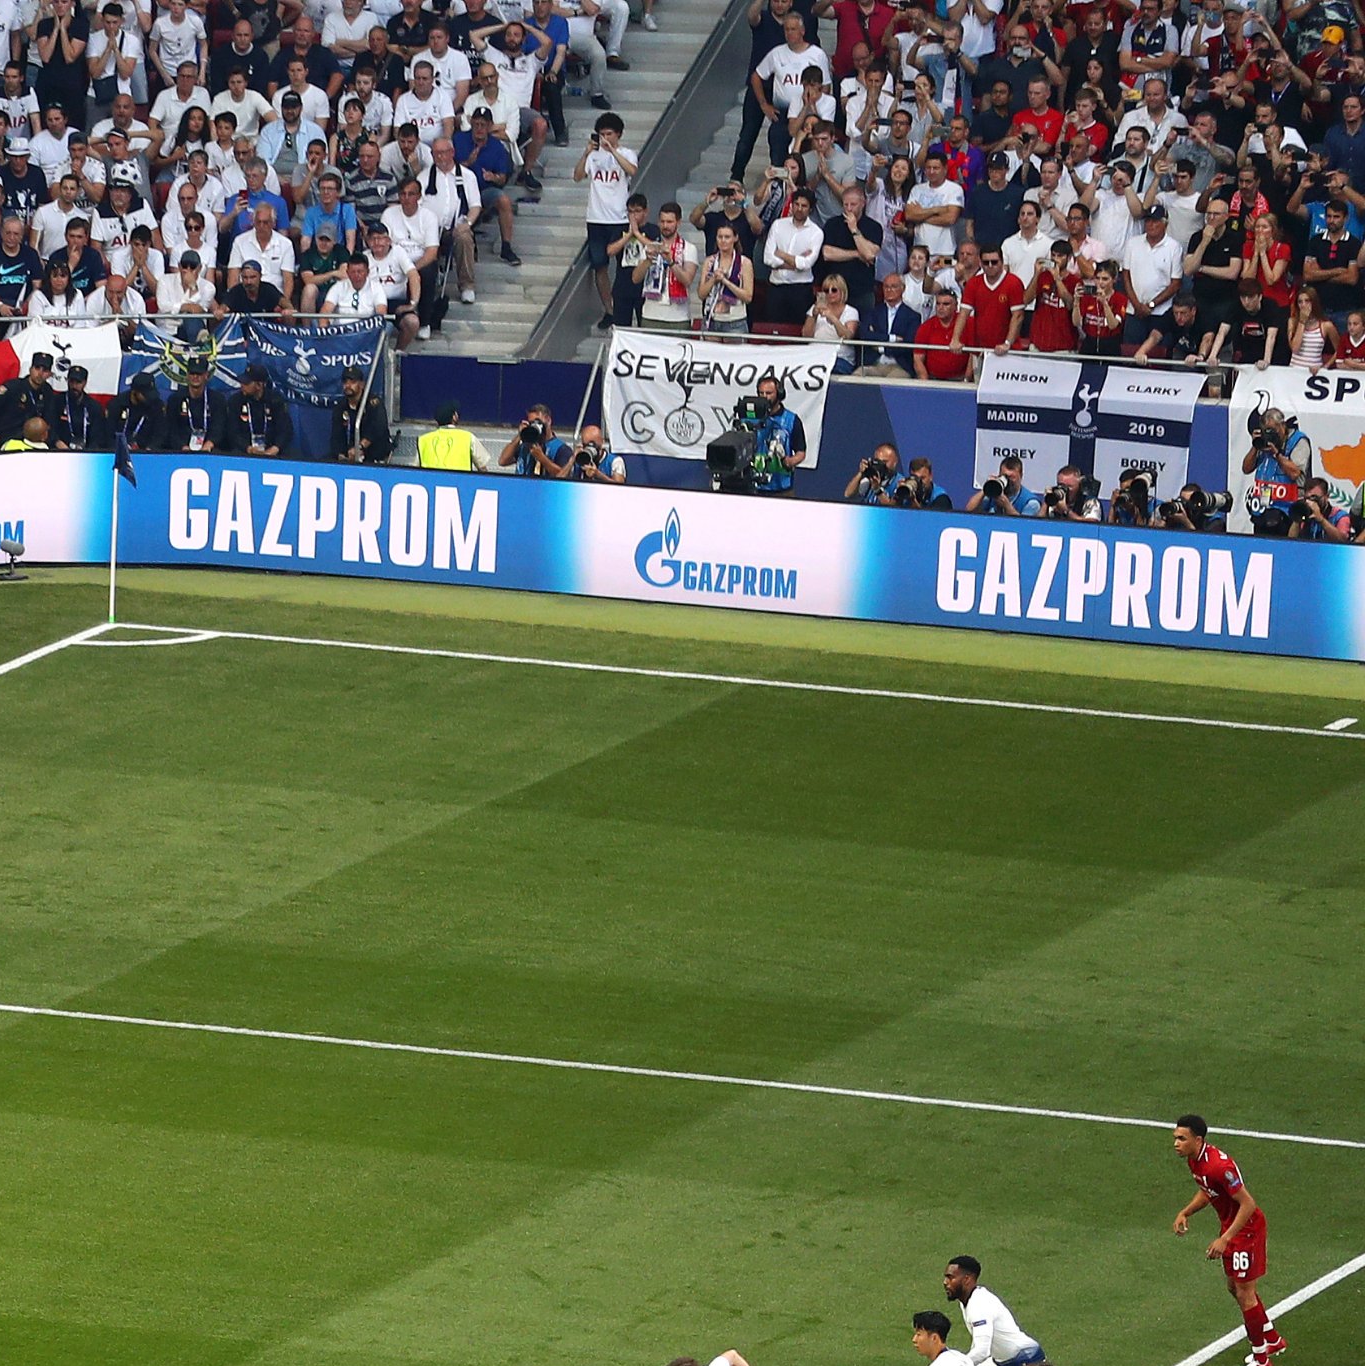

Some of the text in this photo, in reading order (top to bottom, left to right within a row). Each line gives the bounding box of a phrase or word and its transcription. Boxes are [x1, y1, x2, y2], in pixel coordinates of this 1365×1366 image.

[593, 169, 621, 183] AIA
[316, 315, 384, 337] HOTSPUR
[613, 350, 827, 392] SEVENOAKS
[996, 371, 1049, 384] HINSON
[1126, 384, 1183, 397] CLARKY
[987, 409, 1038, 424] MADRID
[1128, 421, 1165, 438] 2019
[992, 447, 1037, 460] ROSEY
[1120, 458, 1167, 472] BOBBY
[169, 468, 498, 574] GAZPROM
[683, 561, 797, 600] GAZPROM
[936, 526, 1273, 640] GAZPROM
[1232, 1250, 1250, 1272] 66
